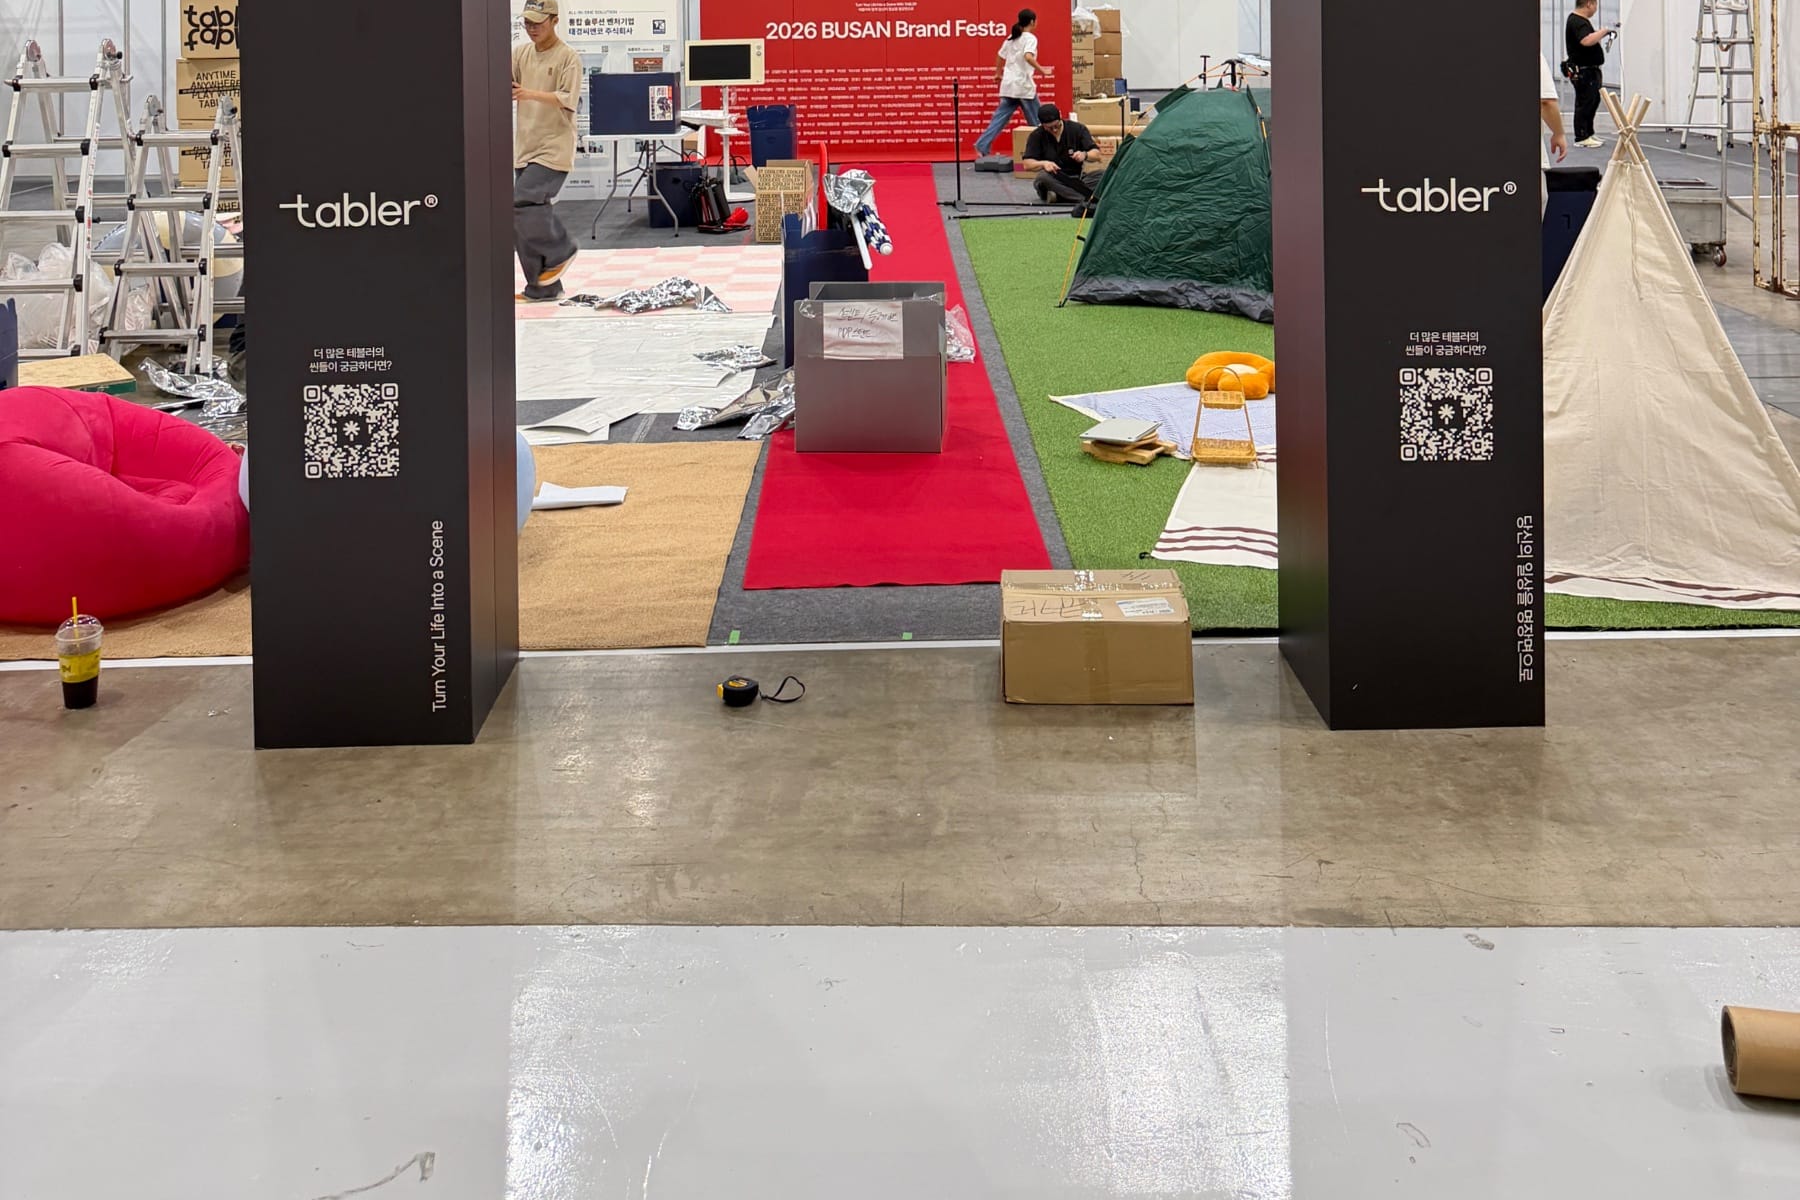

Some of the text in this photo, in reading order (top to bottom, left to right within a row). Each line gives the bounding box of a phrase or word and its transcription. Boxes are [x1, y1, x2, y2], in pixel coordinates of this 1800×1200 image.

[765, 19, 1007, 40] 2026 BUSAN Brand Festa
[196, 70, 237, 81] ANYTIME
[1410, 331, 1480, 342] 더 많은 테블러의
[313, 346, 385, 359] 더 많은 테블러의
[1405, 344, 1487, 356] 씬들이 궁금하다면?
[309, 360, 393, 373] 씬들이 궁금하다면?
[1517, 515, 1534, 683] 당신의 일상을 명장면으로
[429, 520, 447, 713] Turn Your Life Into a Scene
